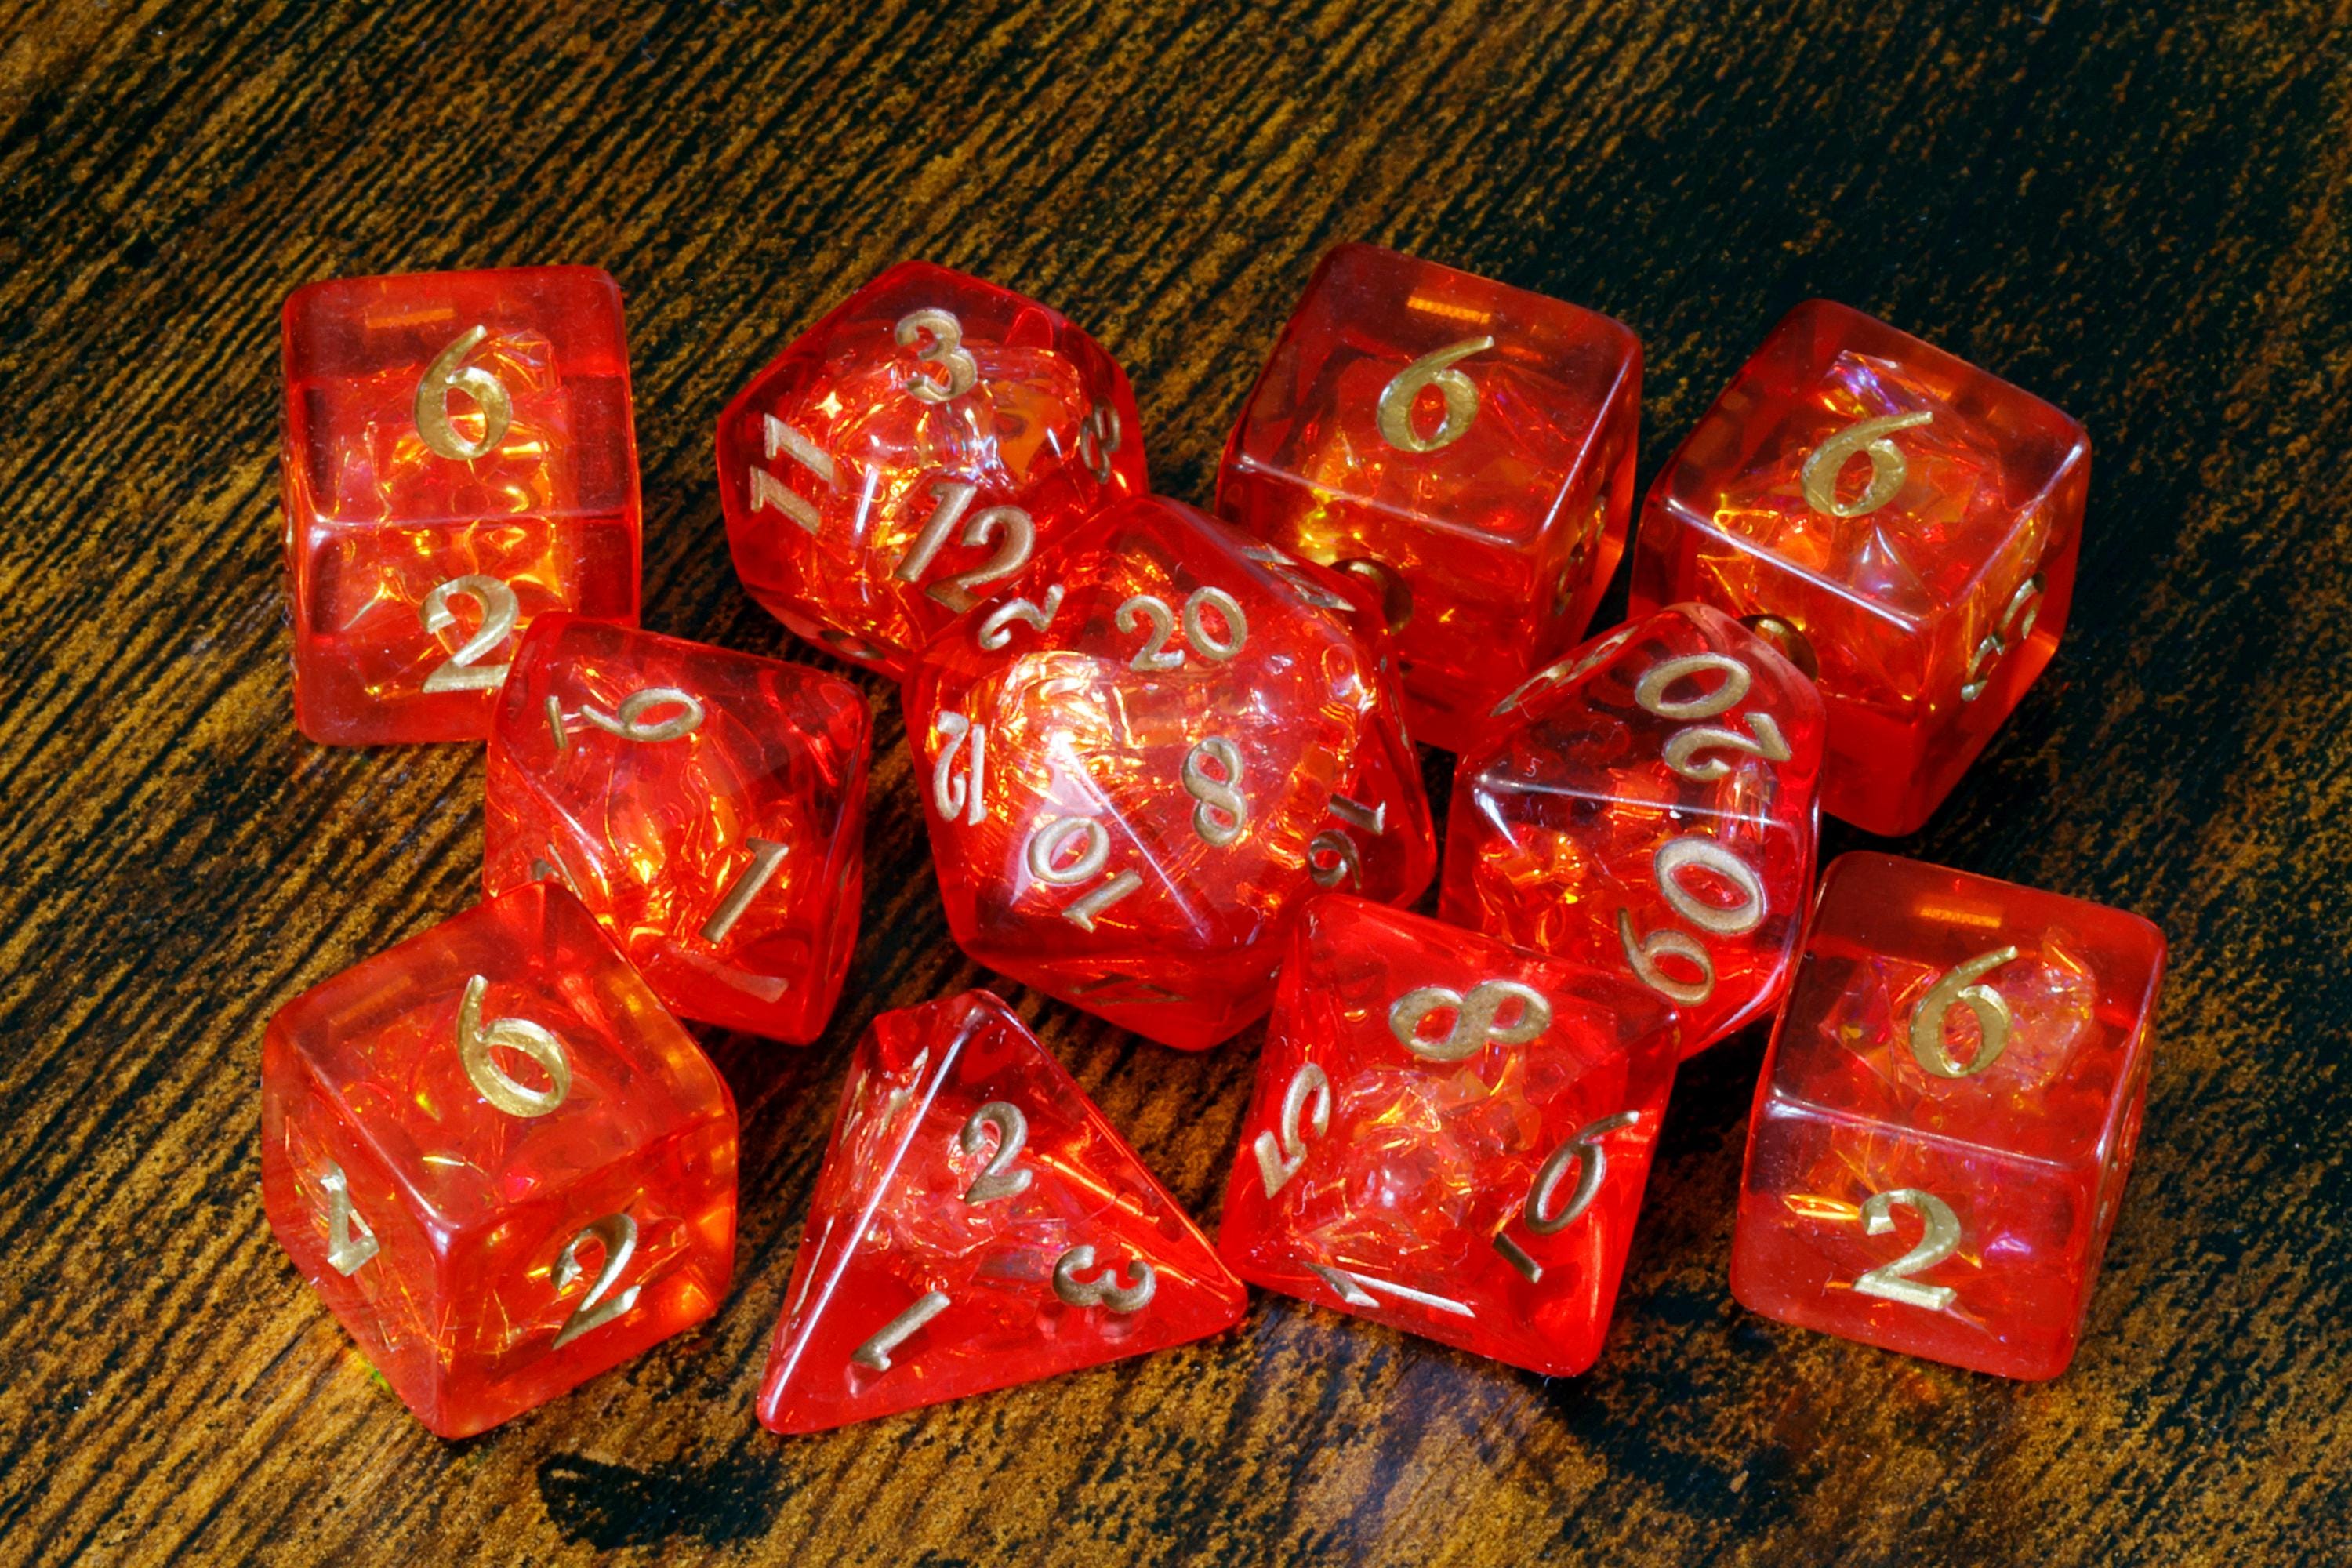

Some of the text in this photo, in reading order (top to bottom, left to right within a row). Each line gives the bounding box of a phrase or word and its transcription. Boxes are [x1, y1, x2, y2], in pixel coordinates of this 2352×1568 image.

[414, 325, 513, 461] 6
[895, 308, 978, 404] 3
[1377, 336, 1494, 453] 6
[750, 413, 834, 536] 11
[1802, 410, 1933, 517] 6
[894, 483, 1036, 613] 12
[419, 574, 519, 693] 2
[978, 583, 1065, 651] 2
[1115, 586, 1247, 673] 20
[1635, 652, 1791, 782] 20
[1181, 735, 1247, 848] 8
[699, 837, 789, 944] 1
[1028, 815, 1143, 933] 10
[1618, 831, 1769, 1006] 60
[456, 973, 572, 1119] 6
[1389, 979, 1552, 1062] 8
[1909, 946, 2018, 1079] 6
[961, 1101, 1033, 1205] 2
[1254, 1062, 1330, 1200] 5
[320, 1160, 380, 1277] 4
[1852, 1188, 1961, 1311] 2
[550, 1212, 641, 1351] 2
[851, 1290, 951, 1372] 1
[1052, 1245, 1156, 1314] 3
